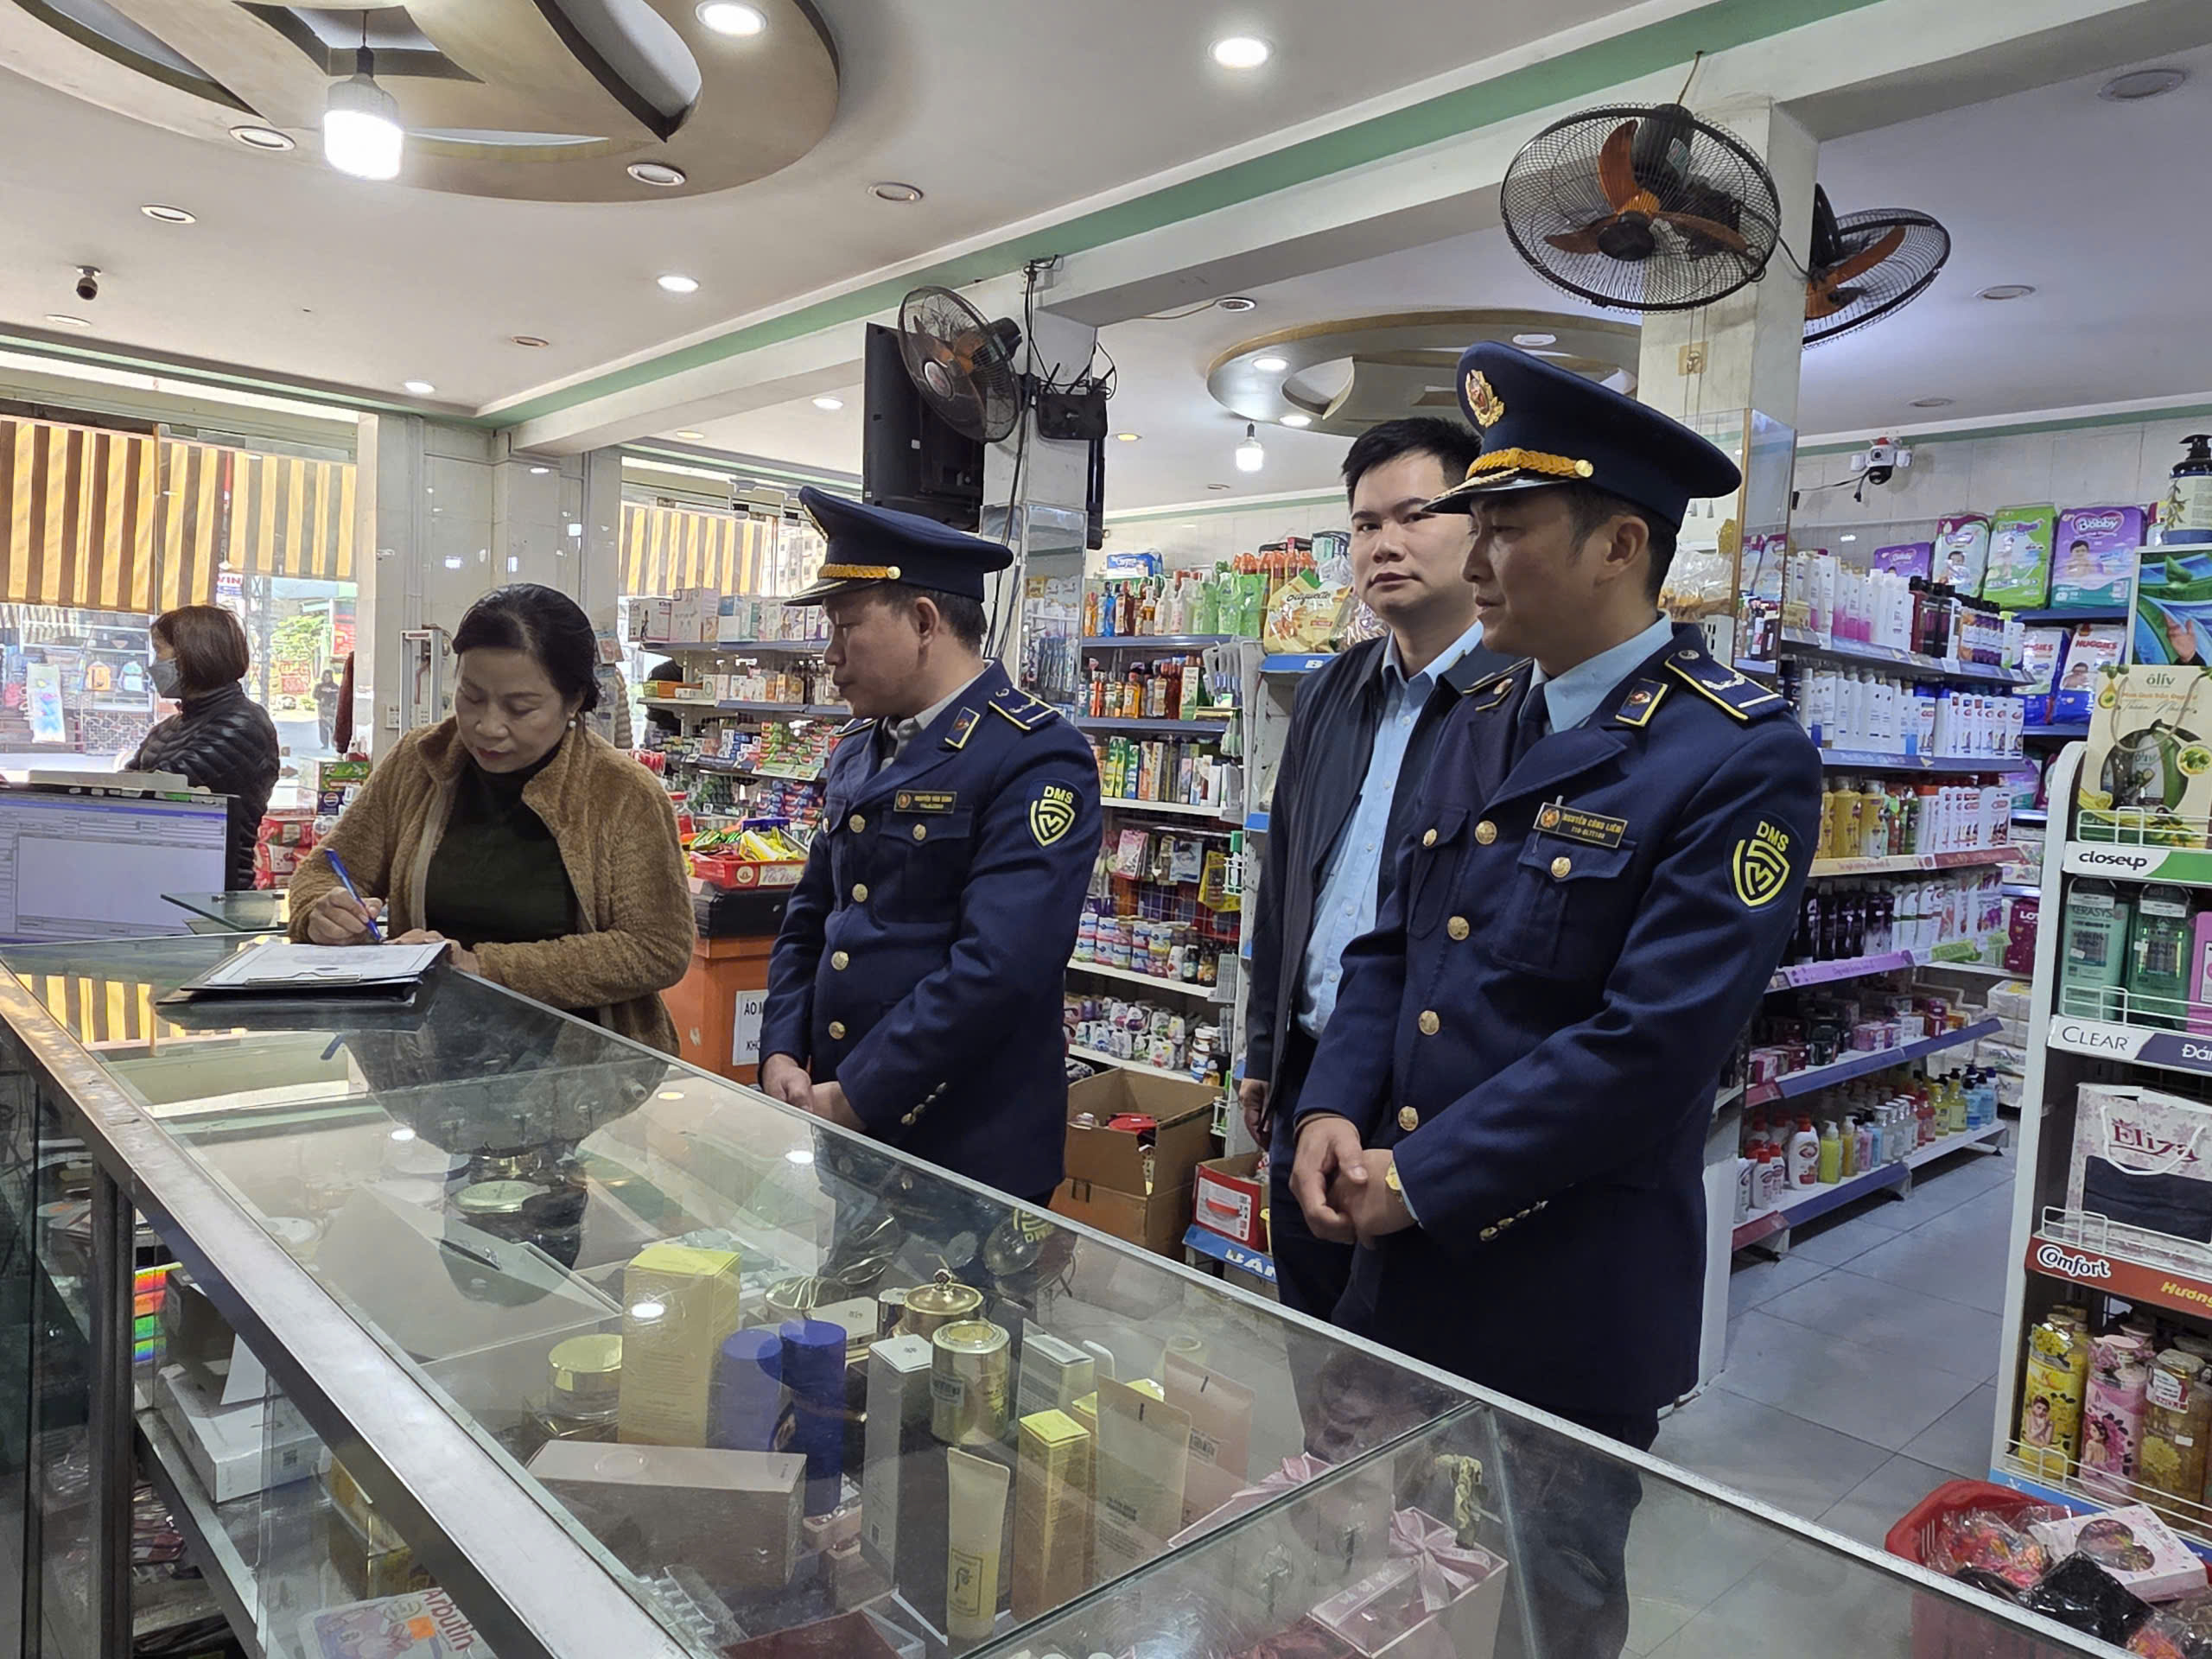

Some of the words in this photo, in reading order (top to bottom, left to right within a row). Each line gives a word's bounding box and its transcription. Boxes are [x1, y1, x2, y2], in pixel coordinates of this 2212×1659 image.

[2075, 639, 2117, 650] HUGGIES
[1044, 785, 1074, 804] DMS
[1756, 820, 1789, 852] DMS
[2079, 851, 2148, 871] closeup
[2062, 1027, 2128, 1051] CLEAR
[2113, 1123, 2201, 1163] Eliza
[2037, 1244, 2111, 1278] Comfort
[421, 1589, 474, 1651] Arbutin
